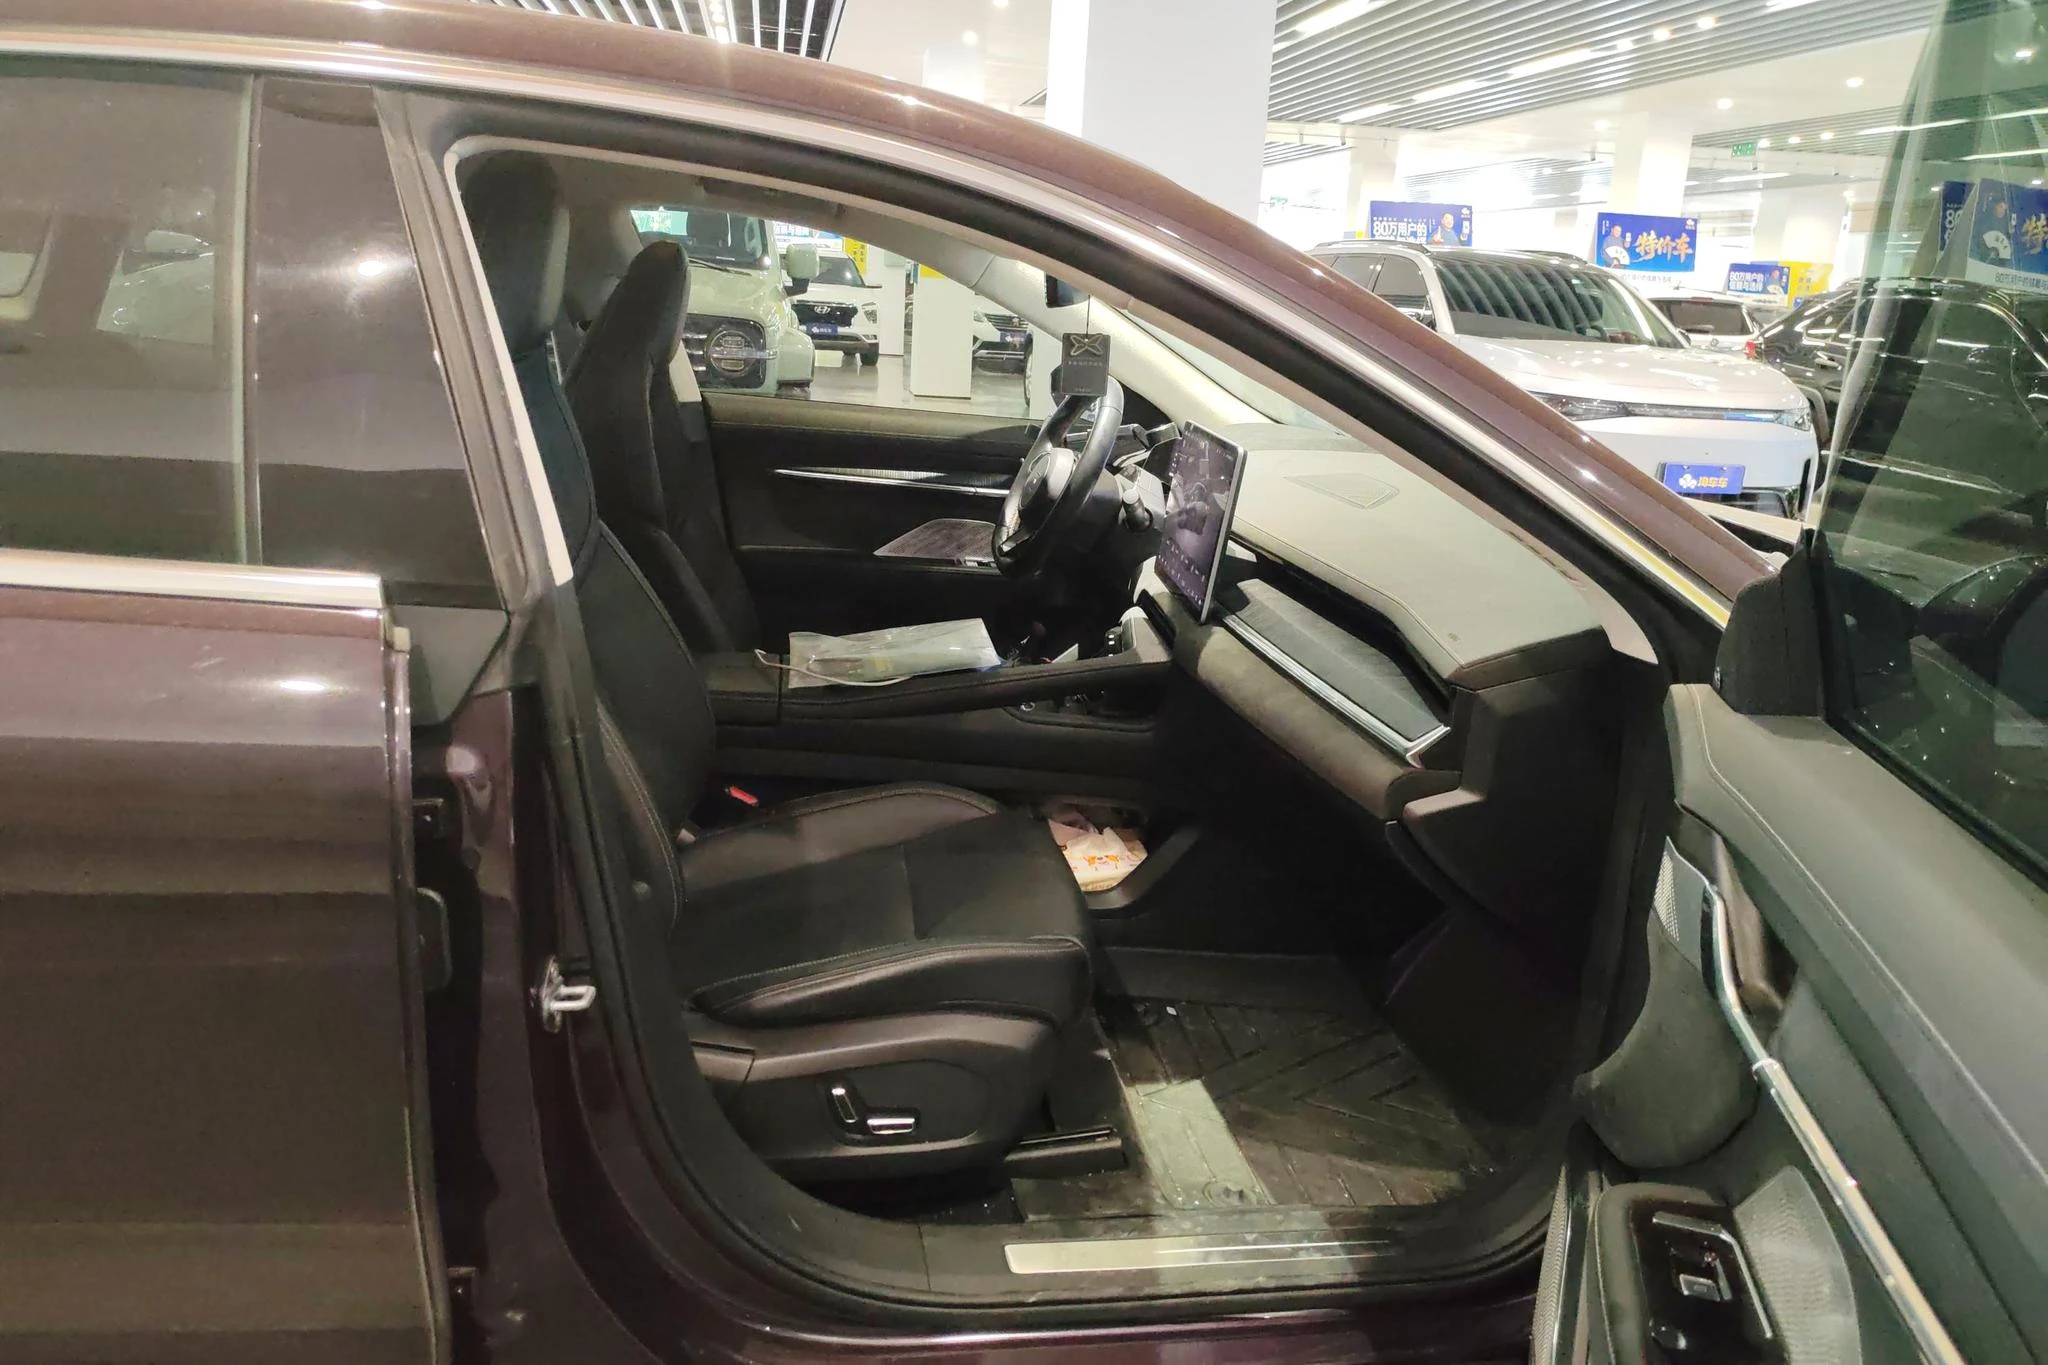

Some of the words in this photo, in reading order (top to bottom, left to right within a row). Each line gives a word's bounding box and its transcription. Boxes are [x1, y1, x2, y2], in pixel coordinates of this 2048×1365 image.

[1373, 221, 1427, 237] 80万用户的
[1632, 229, 1694, 264] 特价车
